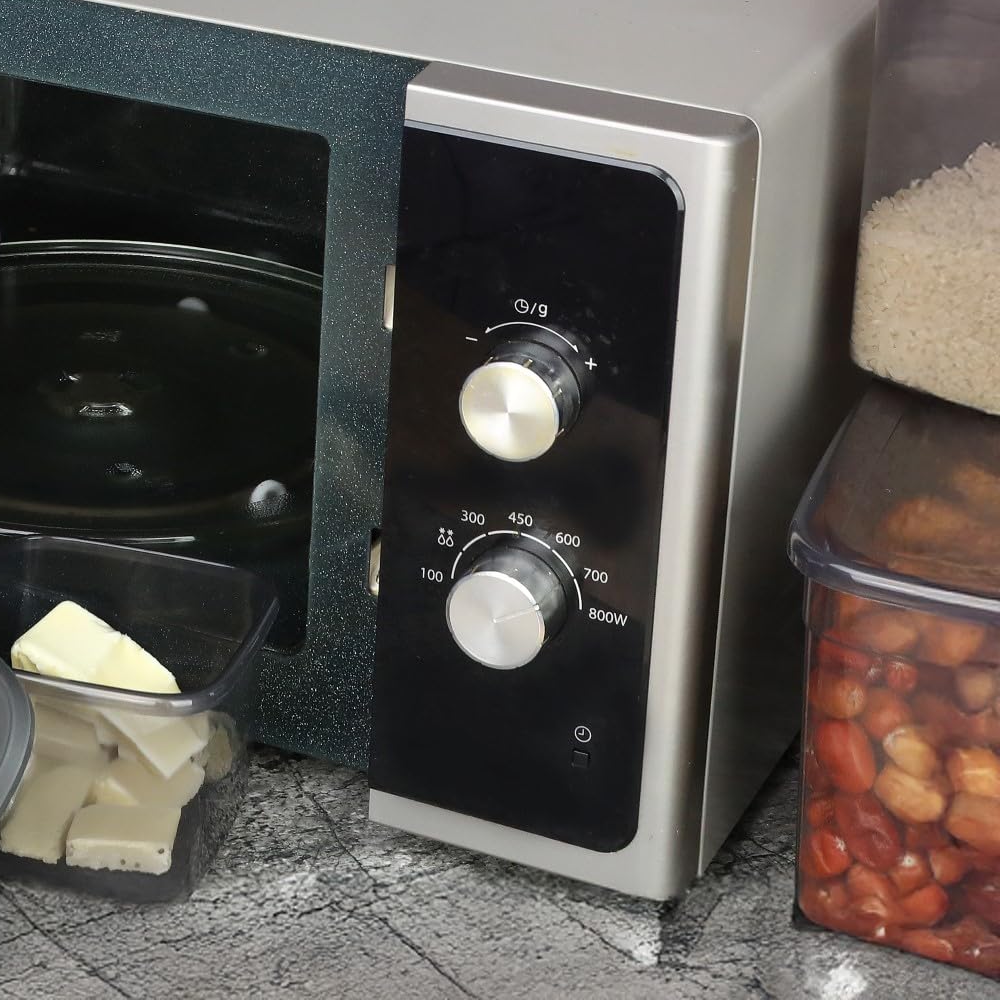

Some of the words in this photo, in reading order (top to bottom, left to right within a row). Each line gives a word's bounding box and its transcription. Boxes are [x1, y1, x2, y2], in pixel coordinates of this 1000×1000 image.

[460, 509, 485, 526] 300
[508, 511, 533, 527] 450
[555, 531, 581, 548] 600
[420, 567, 443, 583] 100
[583, 567, 609, 584] 700
[588, 607, 628, 627] 800W
